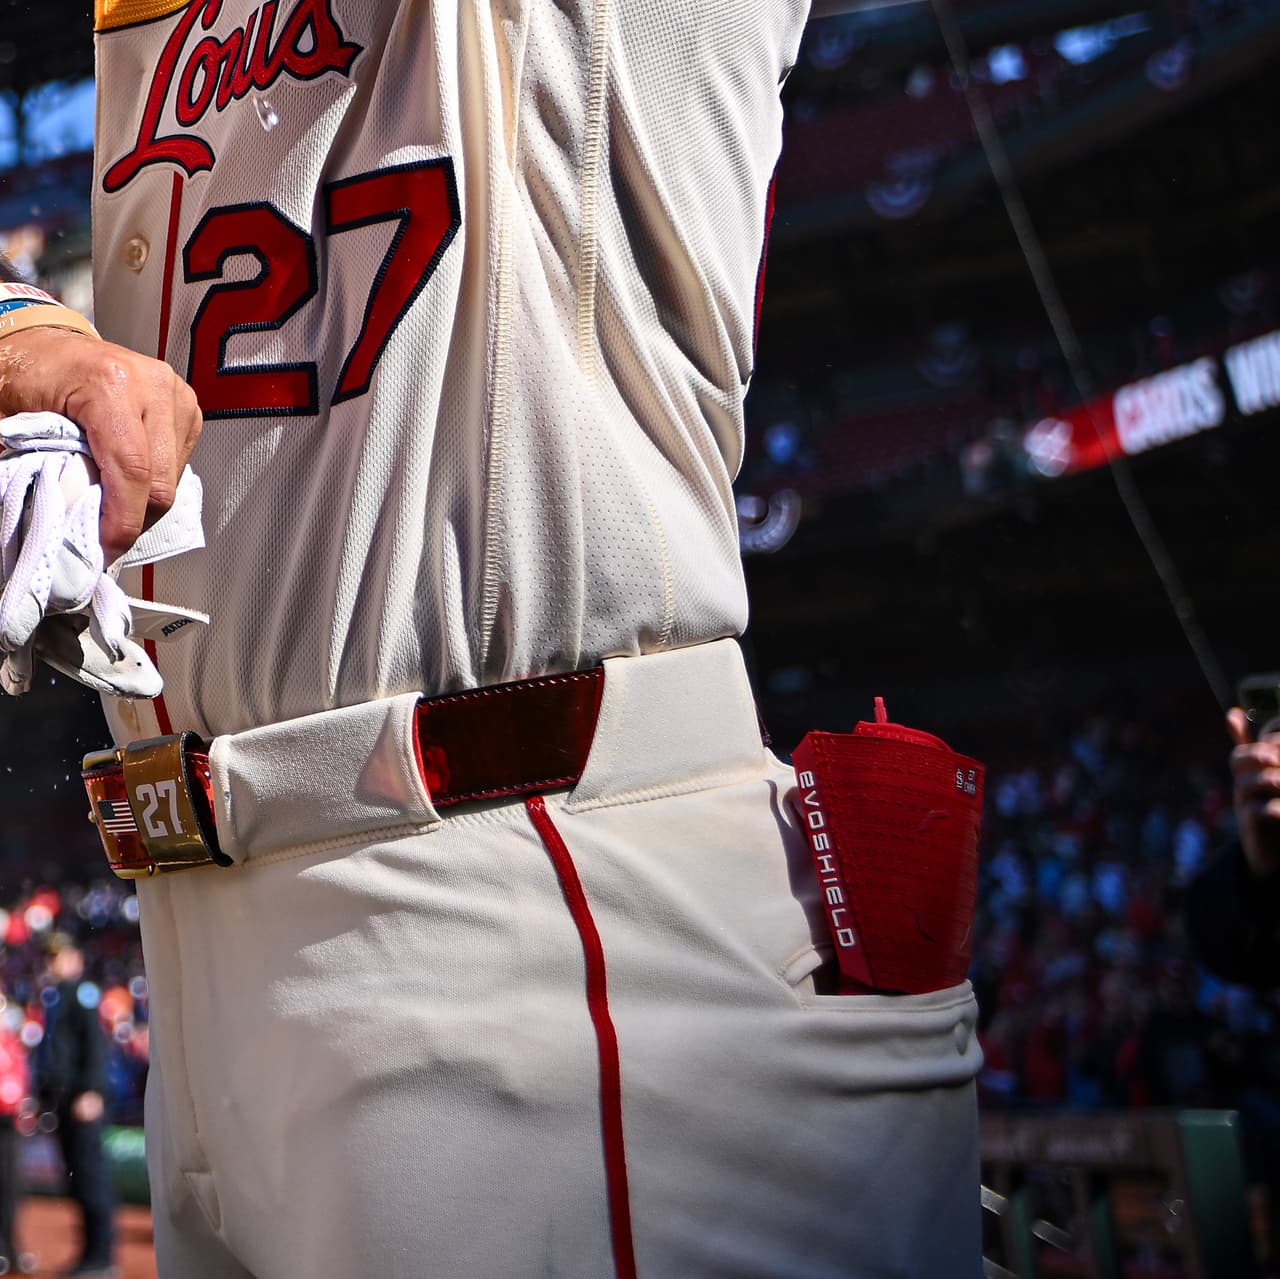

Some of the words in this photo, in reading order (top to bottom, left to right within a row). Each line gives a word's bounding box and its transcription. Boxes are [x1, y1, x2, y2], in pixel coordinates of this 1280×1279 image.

[184, 156, 461, 421] 27
[135, 780, 184, 839] 27
[799, 770, 856, 948] EVOSHIELD
